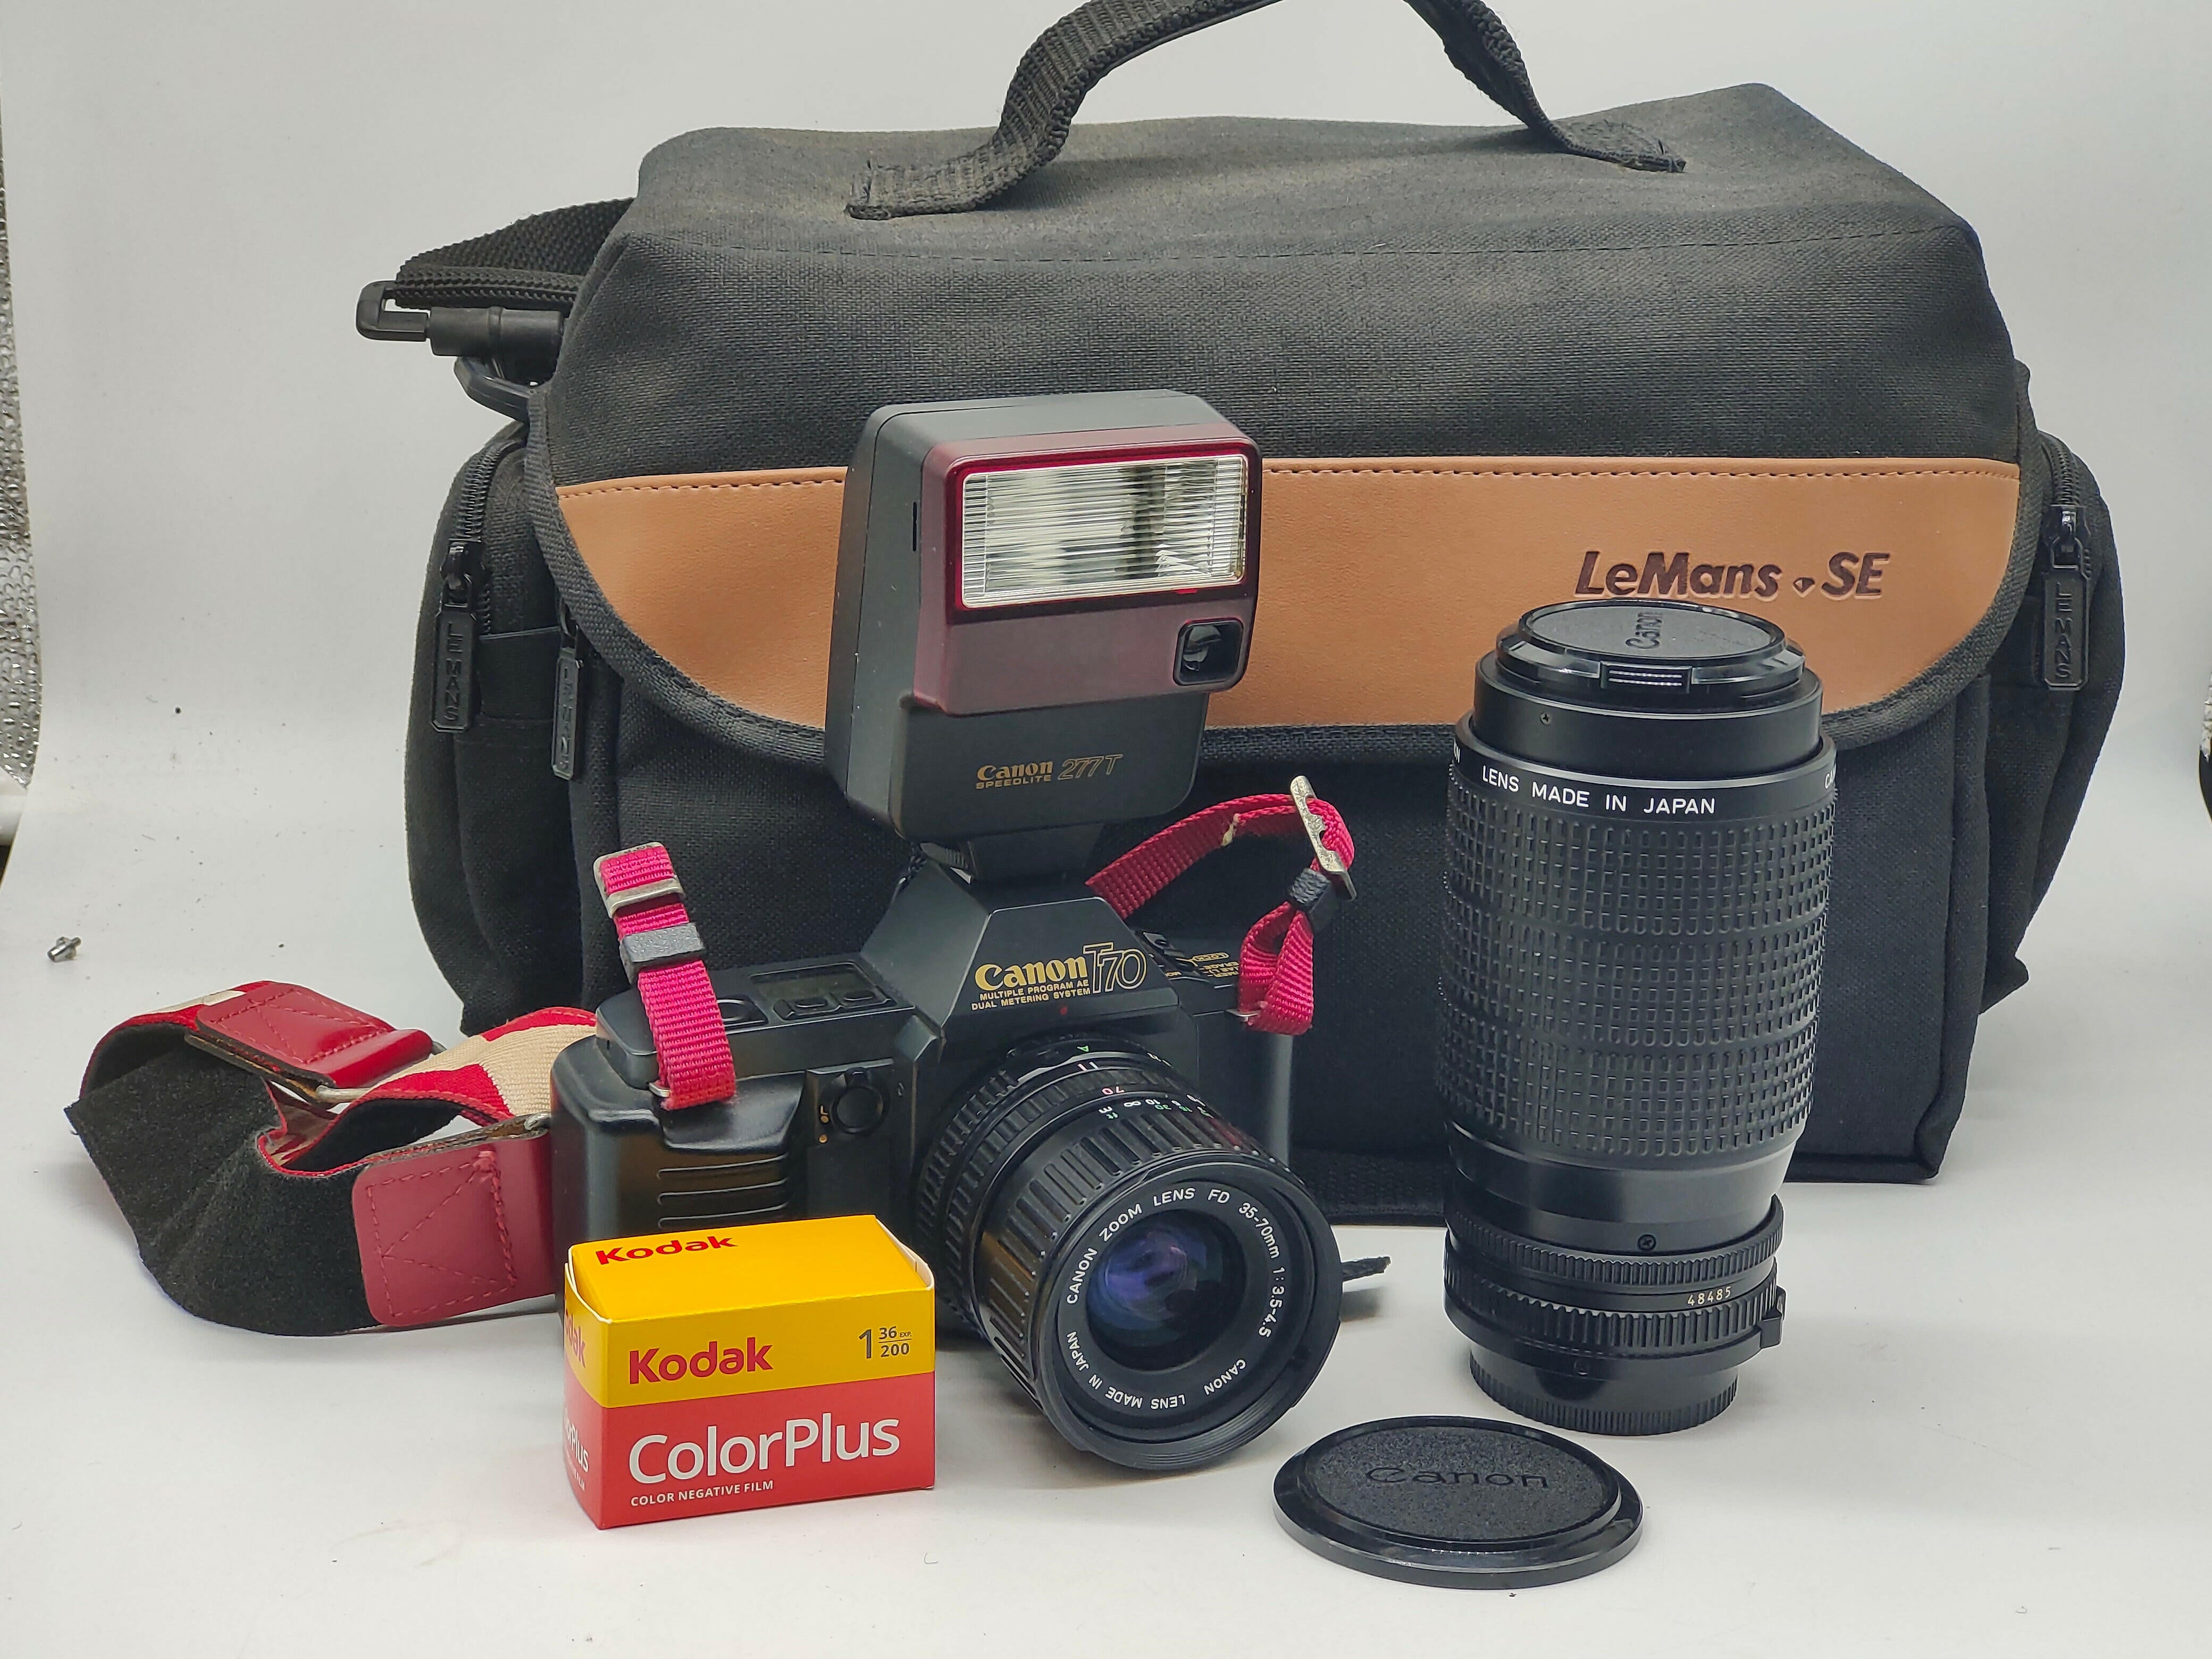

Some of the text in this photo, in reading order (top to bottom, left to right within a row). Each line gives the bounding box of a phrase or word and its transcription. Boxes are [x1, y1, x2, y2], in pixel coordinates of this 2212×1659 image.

[1575, 551, 1890, 597] LeMans SE
[2055, 617, 2073, 678] MANS
[443, 659, 462, 721] MANS
[976, 775, 1051, 789] SPEEDLITE
[977, 754, 1123, 781] Canon 277T
[1481, 765, 1715, 815] LENS MADE IN JAPAN
[974, 942, 1147, 994] Canon T70
[971, 987, 1091, 1011] DUAL METERING SYSTEM
[979, 979, 1090, 1001] MULTIPLE PROGRAM AE
[596, 1235, 739, 1266] Kodak
[1067, 1247, 1098, 1304] CANON
[1099, 1203, 1143, 1242] ZOOM
[1153, 1187, 1196, 1206] LENS
[1208, 1188, 1230, 1203] FD
[1238, 1202, 1280, 1259] 35-70mm
[1687, 1285, 1732, 1307] 48485
[859, 1329, 872, 1359] 1
[878, 1326, 898, 1339] 36
[629, 1336, 774, 1385] Kodak
[881, 1343, 910, 1358] 200
[1067, 1330, 1246, 1410] CANON LENS MADE IN JAPAN
[629, 1412, 900, 1484] ColorPlus
[1365, 1466, 1548, 1489] Canon
[631, 1480, 774, 1507] COLOR NEGATIVE FILM
